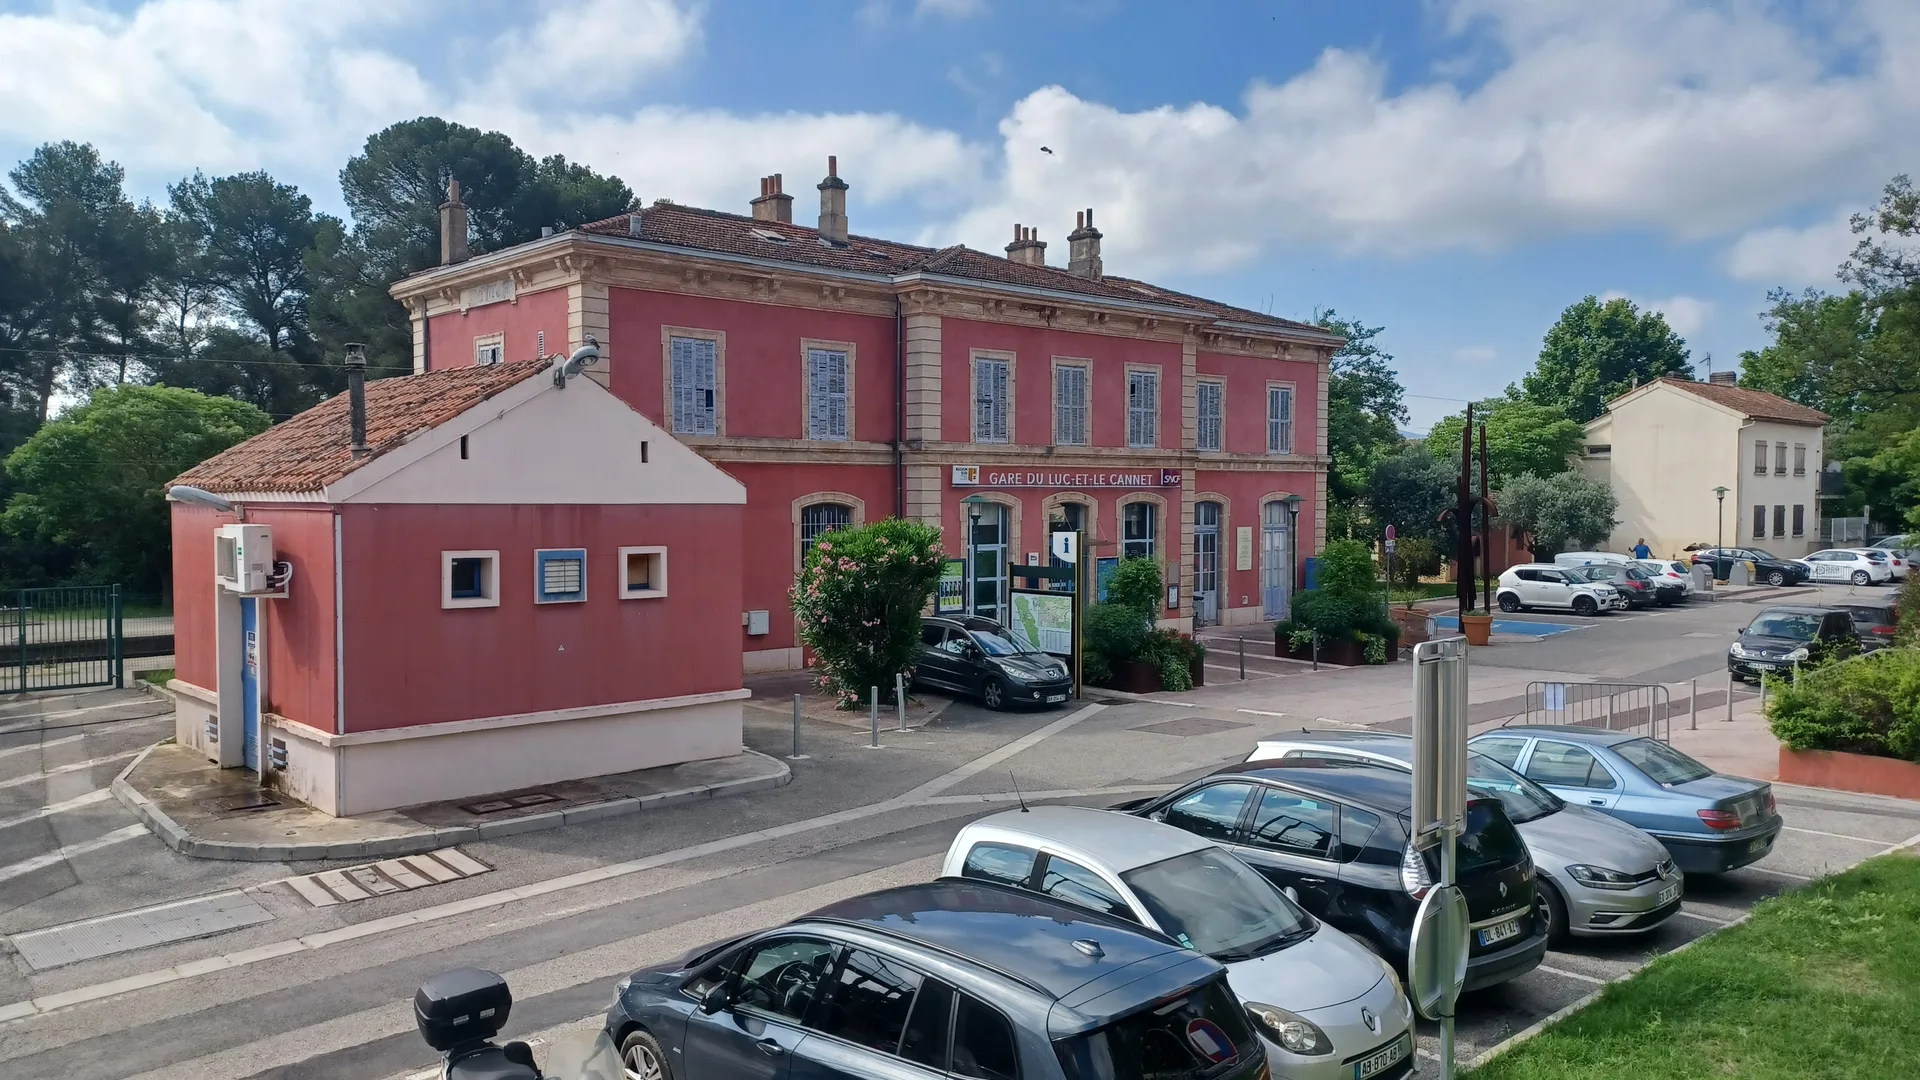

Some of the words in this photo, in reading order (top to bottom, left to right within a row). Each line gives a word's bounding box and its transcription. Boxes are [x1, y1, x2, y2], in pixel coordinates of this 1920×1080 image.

[989, 472, 1022, 485] GARE
[1027, 473, 1044, 485] DU
[1048, 473, 1106, 486] LUC-ET-LE
[1109, 474, 1153, 486] CANNET
[1163, 474, 1181, 484] SNCF
